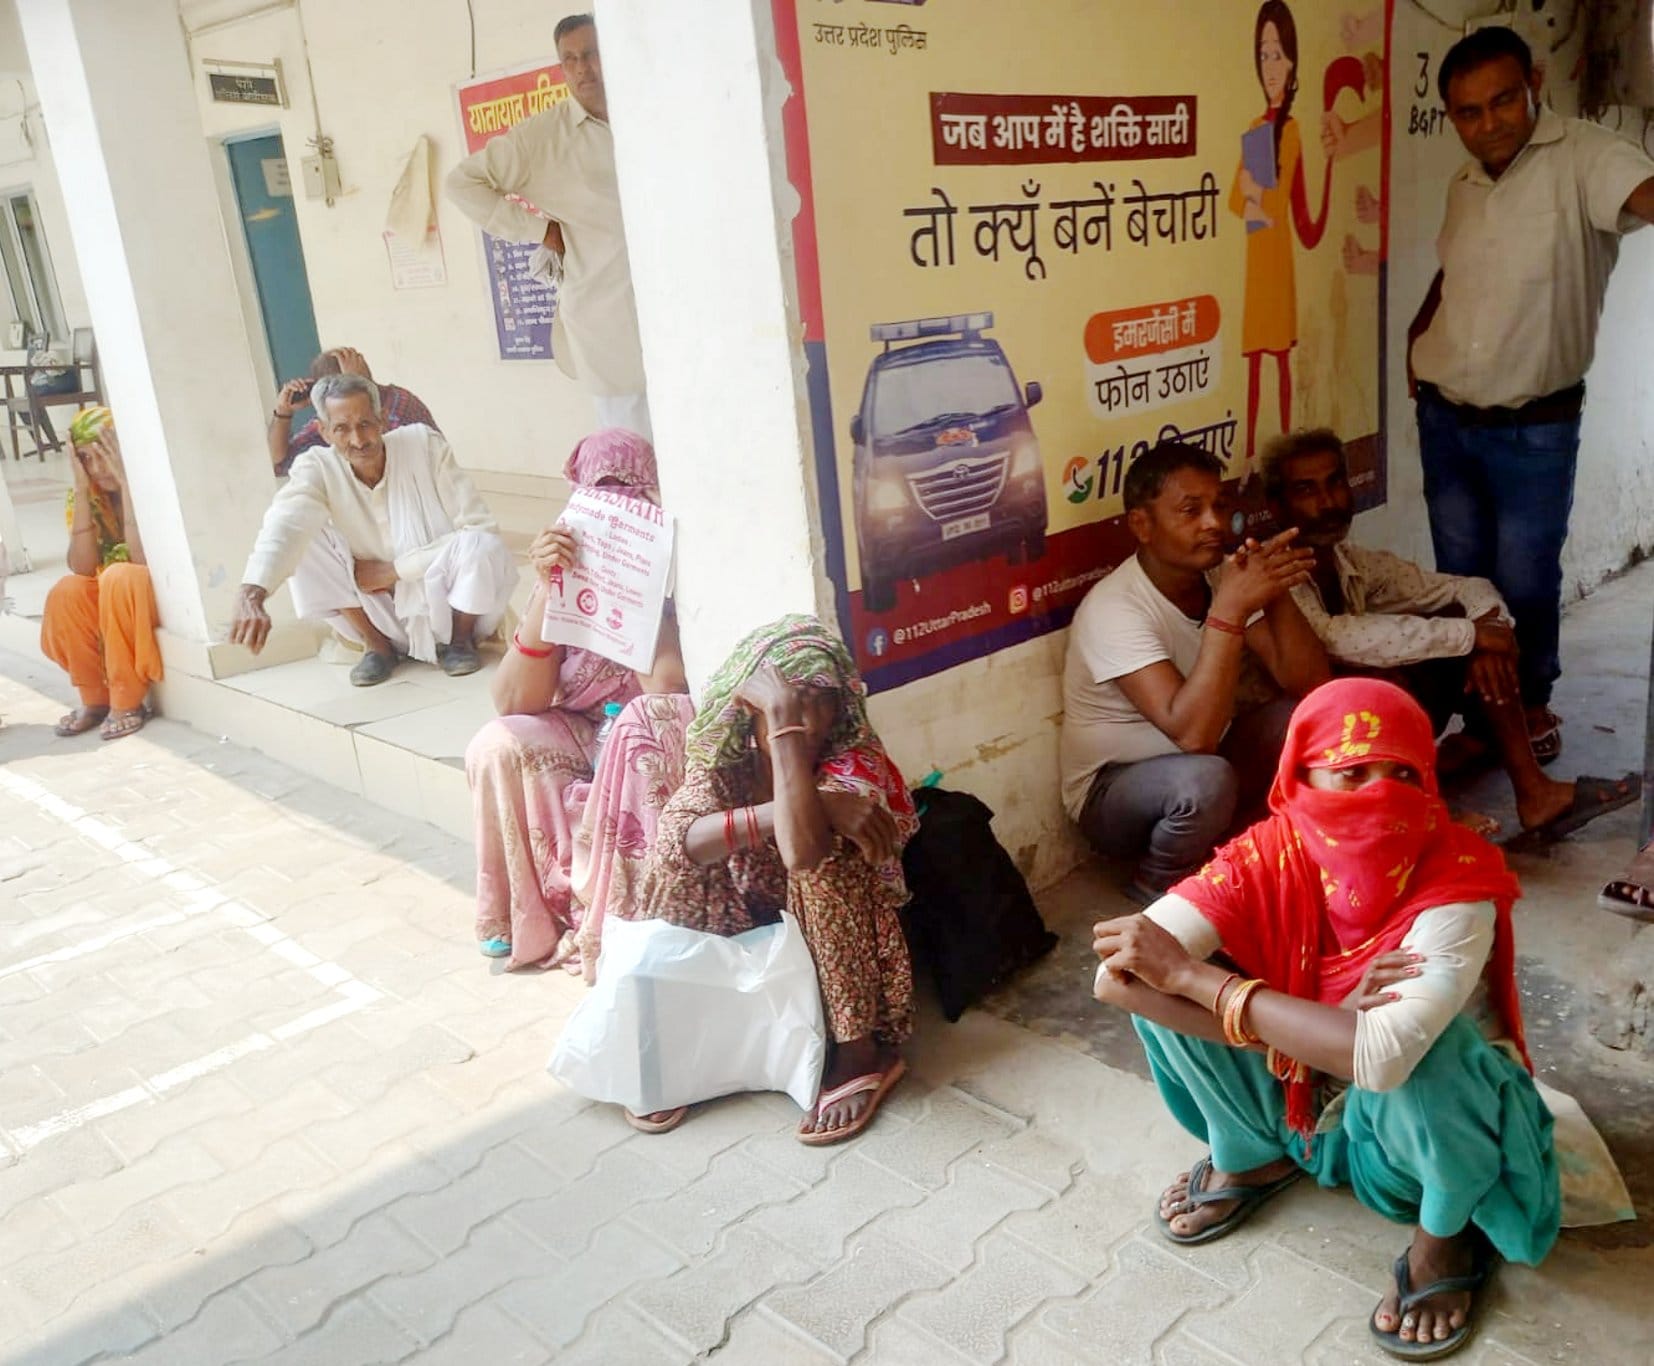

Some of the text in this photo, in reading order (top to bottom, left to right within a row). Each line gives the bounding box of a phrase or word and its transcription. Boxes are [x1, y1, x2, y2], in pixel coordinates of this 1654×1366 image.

[813, 22, 928, 55] उत्तर प्रदेश पुलिस
[940, 102, 1190, 153] जब आप में है शक्ति सारी
[904, 171, 1220, 280] तो क्यूँ बनें बेचारी
[1181, 302, 1198, 338] में
[1095, 348, 1210, 412] फोन उठाएं
[893, 600, 992, 645] @112UttarPradesh
